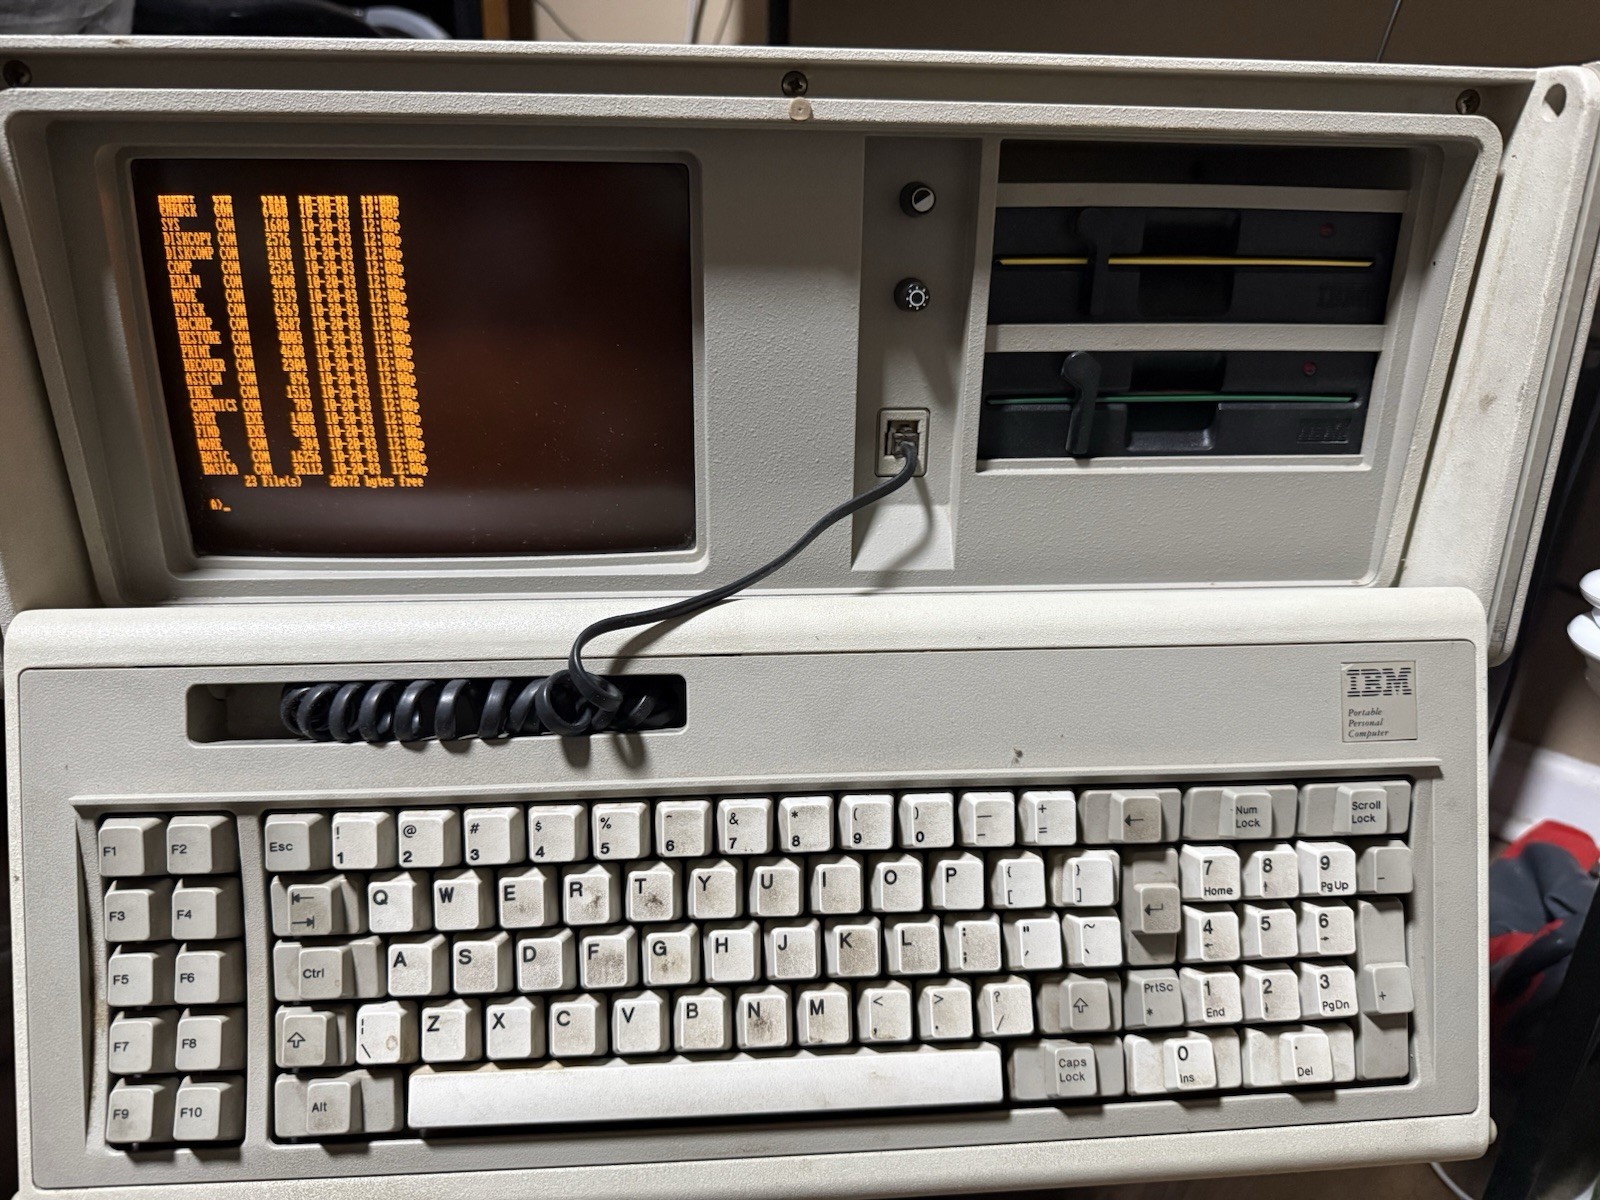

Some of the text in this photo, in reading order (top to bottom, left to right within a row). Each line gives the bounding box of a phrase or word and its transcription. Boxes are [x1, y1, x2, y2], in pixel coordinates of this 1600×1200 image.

[161, 218, 180, 231] SYS
[215, 218, 235, 231] COM
[301, 218, 350, 231] 10-20-83
[163, 232, 211, 245] DISKCOPY
[217, 232, 237, 245] COM
[303, 232, 351, 245] 10-20-83
[165, 246, 214, 260] DISKCOMP
[219, 246, 239, 260] COM
[304, 246, 353, 260] 10-20-83
[167, 260, 192, 274] COMP
[221, 260, 241, 274] COM
[306, 260, 354, 274] 10-20-83
[169, 274, 356, 288] EDLIN COM 10-20-83
[171, 288, 197, 302] MODE
[225, 288, 244, 302] COM
[309, 288, 358, 302] 10-20-83
[174, 303, 205, 316] FDISK
[227, 303, 247, 316] COM
[311, 303, 359, 316] 10-20-83
[176, 317, 212, 330] BACKUP
[229, 317, 248, 330] COM
[313, 317, 361, 330] 10-20-83
[231, 331, 251, 344] COM
[181, 345, 253, 358] PRINT COM
[236, 358, 255, 371] COM
[238, 372, 257, 385] COM
[240, 385, 259, 398] COM
[242, 399, 262, 412] COM
[324, 399, 371, 412] 10-20-83
[193, 412, 373, 425] SORT EXE 10-20-83
[195, 425, 220, 437] FIND
[246, 425, 266, 437] EXE
[327, 425, 375, 437] 10-20-83
[197, 437, 223, 450] MORE
[249, 437, 268, 450] COM
[330, 437, 377, 450] 10-20-83
[200, 450, 230, 462] BASIC
[251, 450, 271, 462] COM
[332, 450, 379, 462] 10-20-83
[202, 462, 238, 475] BASICA
[254, 462, 273, 475] COM
[334, 462, 381, 475] 10-20-83
[245, 475, 425, 489] 23 File(s) 28672 bytes free
[1346, 667, 1412, 697] IBM
[1348, 707, 1382, 717] Portable
[1348, 718, 1384, 727] Personal
[1348, 730, 1389, 739] Computer
[1236, 806, 1257, 814] Num
[1352, 801, 1380, 810] Scroll
[1236, 819, 1260, 828] Lock
[1352, 814, 1375, 824] Lock
[792, 835, 800, 847] 8
[854, 833, 862, 844] 9
[916, 831, 924, 842] 0
[172, 844, 187, 854] F2
[270, 842, 292, 852] Esc
[601, 843, 609, 854] 5
[666, 840, 674, 851] 6
[729, 838, 737, 849] 7
[103, 847, 116, 856] F1
[337, 852, 343, 864] 1
[403, 851, 412, 862] 2
[471, 849, 479, 860] 3
[536, 846, 545, 857] 4
[1204, 860, 1213, 875] 7
[1263, 858, 1272, 873] 8
[1321, 856, 1330, 870] 9
[761, 874, 773, 889] U
[884, 870, 897, 885] O
[946, 868, 956, 883] P
[570, 882, 582, 897] R
[635, 878, 646, 894] T
[698, 876, 711, 891] Y
[373, 890, 388, 905] Q
[439, 887, 454, 903] W
[504, 885, 515, 901] E
[1204, 887, 1233, 895] Home
[110, 911, 125, 921] F3
[177, 910, 191, 920] F4
[1319, 913, 1328, 928] 6
[1203, 920, 1213, 934] 4
[1261, 916, 1271, 931] 5
[778, 935, 787, 951] J
[840, 933, 852, 949] K
[902, 930, 912, 946] L
[653, 941, 666, 956] G
[716, 937, 728, 953] H
[459, 949, 472, 965] S
[523, 946, 536, 962] D
[588, 944, 599, 960] F
[393, 952, 407, 967] A
[113, 975, 128, 985] F5
[180, 973, 194, 983] F6
[303, 969, 324, 978] Ctrl
[1144, 983, 1173, 993] PrtSc
[1263, 979, 1272, 994] 2
[1320, 974, 1330, 989] 3
[1204, 981, 1210, 996] 1
[687, 1003, 698, 1019] B
[747, 1001, 762, 1019] N
[810, 999, 824, 1015] M
[1323, 1000, 1349, 1011] PgDn
[557, 1011, 570, 1026] C
[622, 1007, 634, 1023] V
[1206, 1008, 1225, 1017] End
[427, 1016, 440, 1032] Z
[493, 1013, 505, 1029] X
[114, 1042, 129, 1052] F7
[182, 1039, 196, 1048] F8
[1178, 1046, 1188, 1061] 0
[1059, 1059, 1086, 1068] Caps
[1060, 1072, 1085, 1082] Lock
[1180, 1074, 1195, 1083] Ins
[1297, 1067, 1313, 1077] Del
[181, 1107, 202, 1118] F10
[312, 1102, 327, 1112] Alt
[113, 1109, 129, 1119] F9
